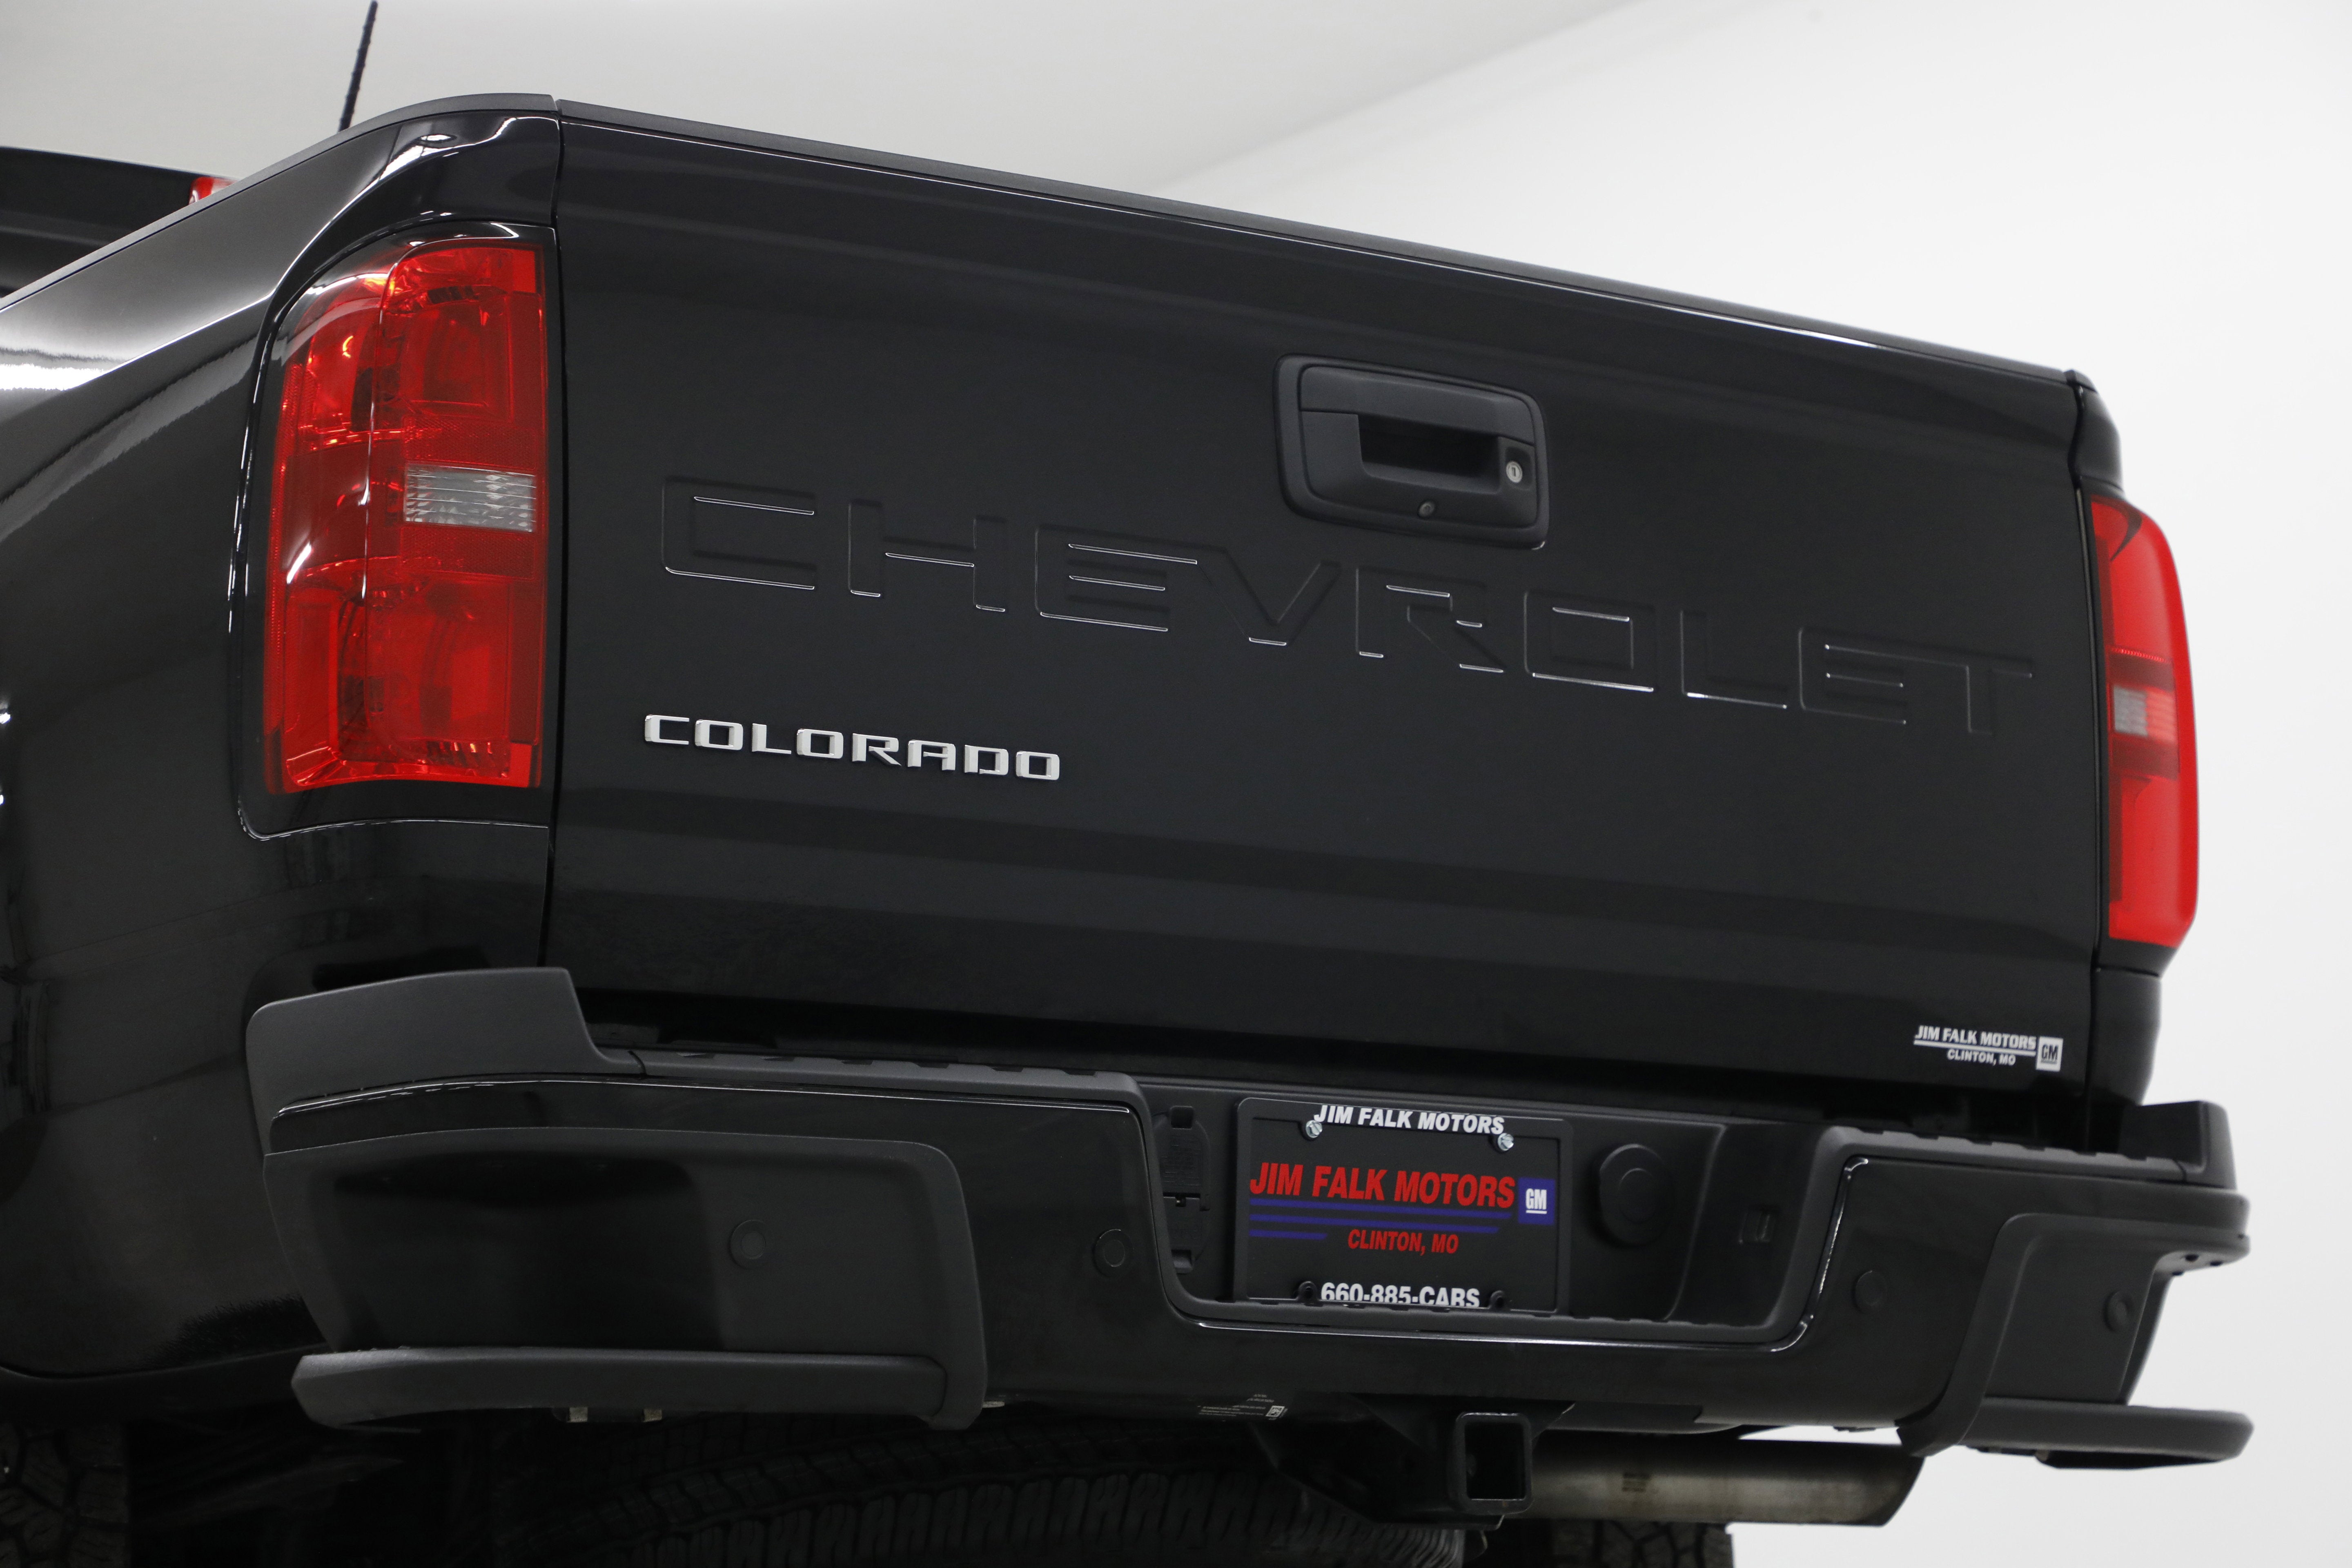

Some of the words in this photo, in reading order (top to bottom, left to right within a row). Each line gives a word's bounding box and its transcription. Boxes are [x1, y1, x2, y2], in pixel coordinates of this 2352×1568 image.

[662, 475, 2033, 736] CHEVROLET
[644, 714, 1060, 781] COLORADO
[1914, 1025, 1940, 1041] JIM
[1942, 1027, 1977, 1045] FALK
[1980, 1031, 2037, 1050] MOTORS
[1947, 1048, 1996, 1066] CLINTON,
[1999, 1054, 2016, 1066] MO
[2041, 1043, 2058, 1061] GM
[1314, 1104, 1354, 1125] JIM
[1357, 1107, 1412, 1129] FALK
[1417, 1112, 1505, 1135] MOTORS
[1250, 1162, 1304, 1196] JIM
[1312, 1165, 1388, 1201] FALK
[1394, 1170, 1516, 1208] MOTORS
[1526, 1188, 1547, 1210] GM
[1348, 1229, 1425, 1255] CLINTON,
[1431, 1234, 1459, 1254] MO
[1321, 1282, 1480, 1307] 660-885-CARS
